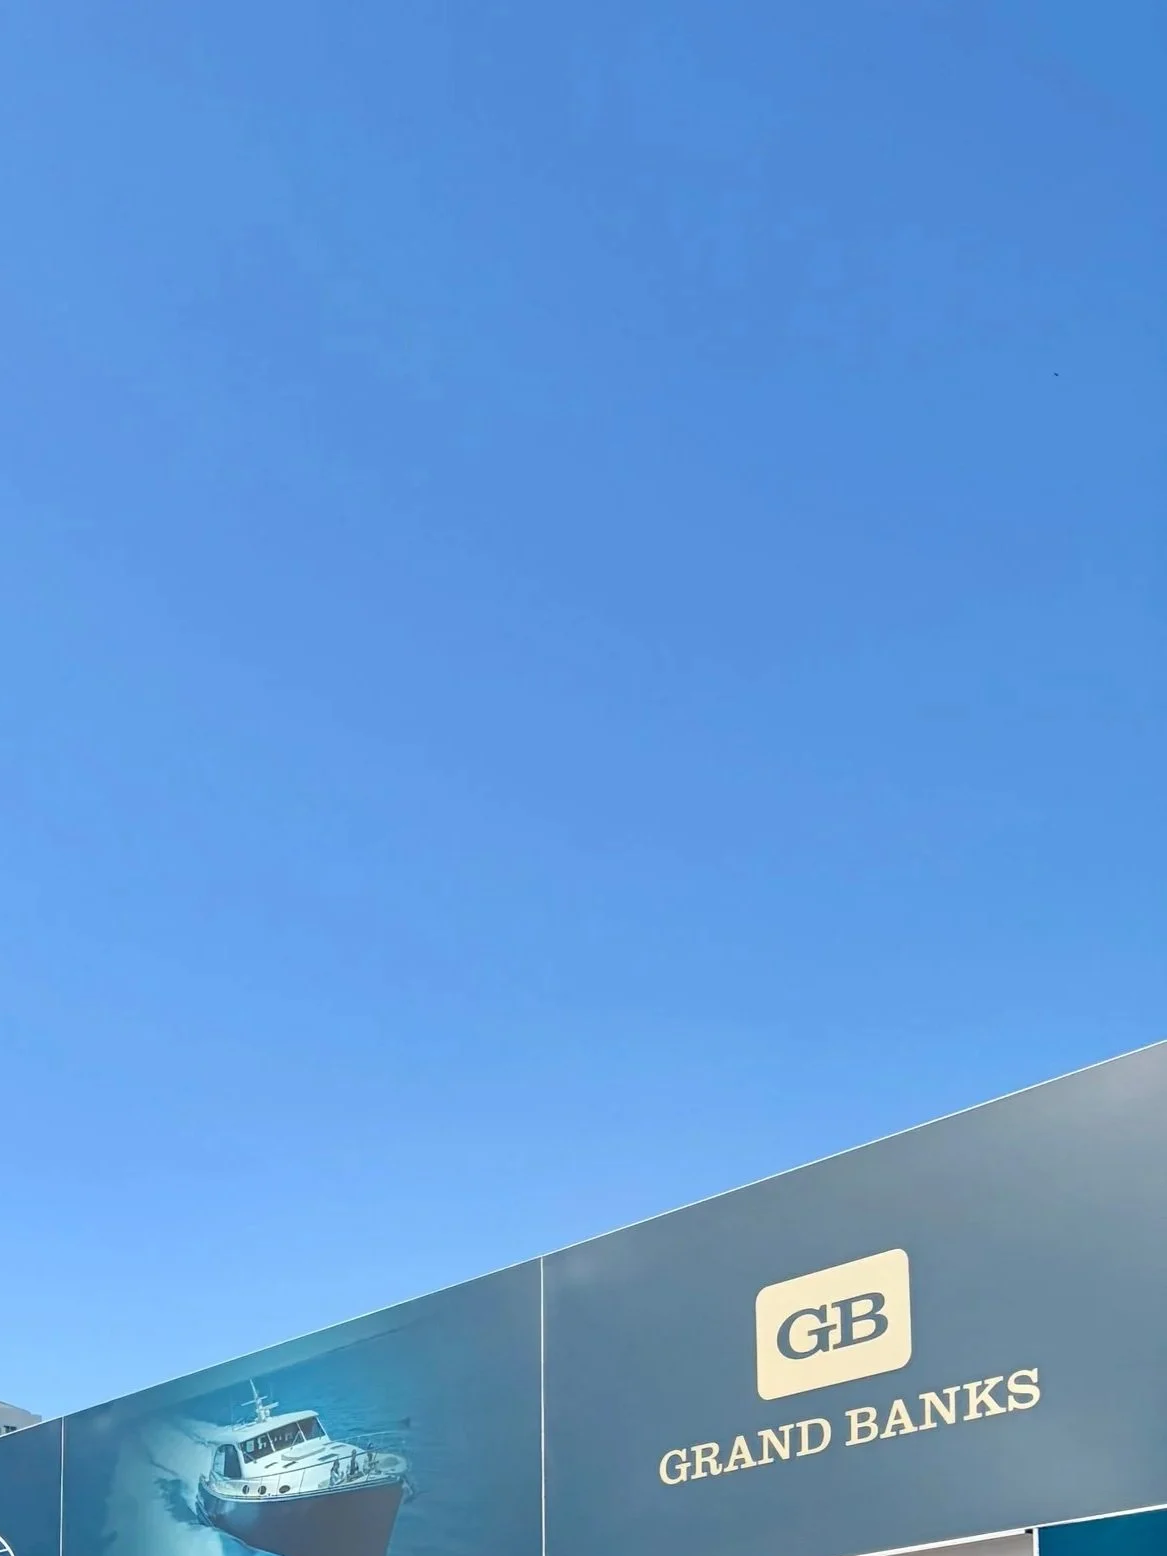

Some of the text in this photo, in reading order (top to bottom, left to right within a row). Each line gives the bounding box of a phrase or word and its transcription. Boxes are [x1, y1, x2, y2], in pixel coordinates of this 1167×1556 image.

[776, 1291, 889, 1360] GB
[658, 1367, 1041, 1485] GRAND BANKS
